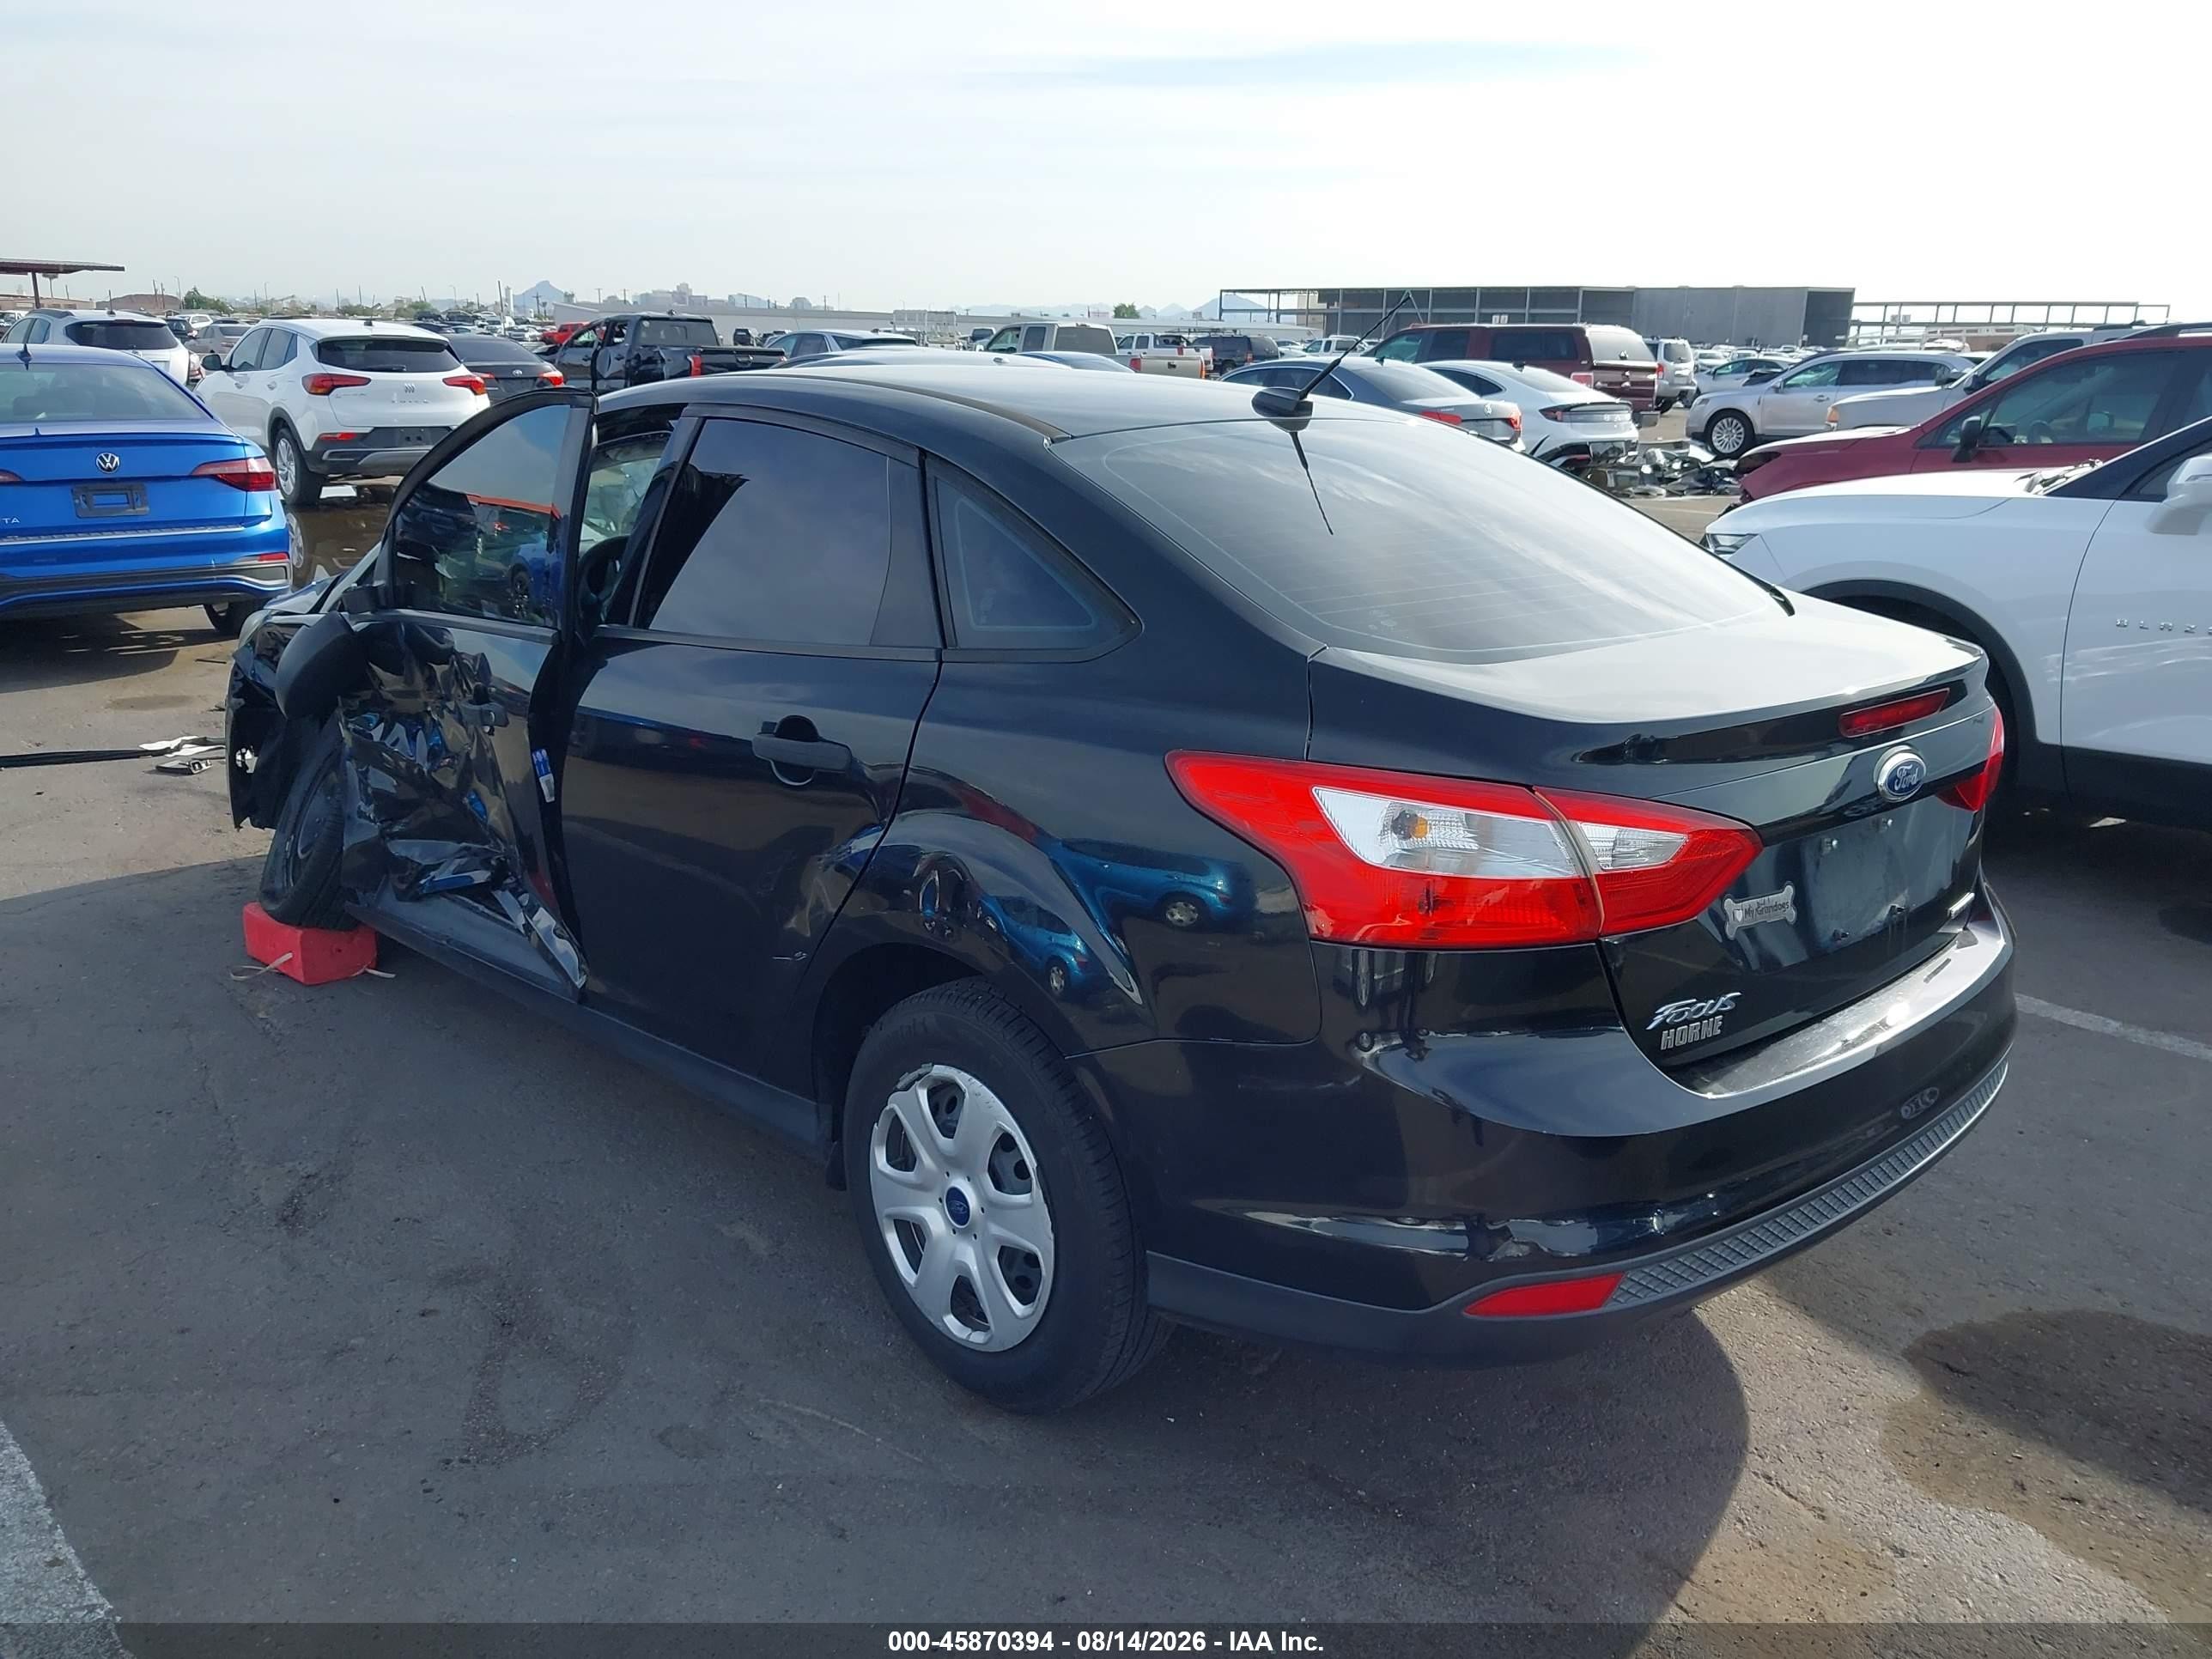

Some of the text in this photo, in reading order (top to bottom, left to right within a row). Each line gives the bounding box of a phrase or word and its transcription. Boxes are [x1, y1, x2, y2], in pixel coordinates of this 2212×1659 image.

[1894, 764, 1919, 791] Ford
[1744, 906, 1757, 921] My
[1645, 992, 1742, 1030] Focus
[1660, 1015, 1723, 1050] HORNE
